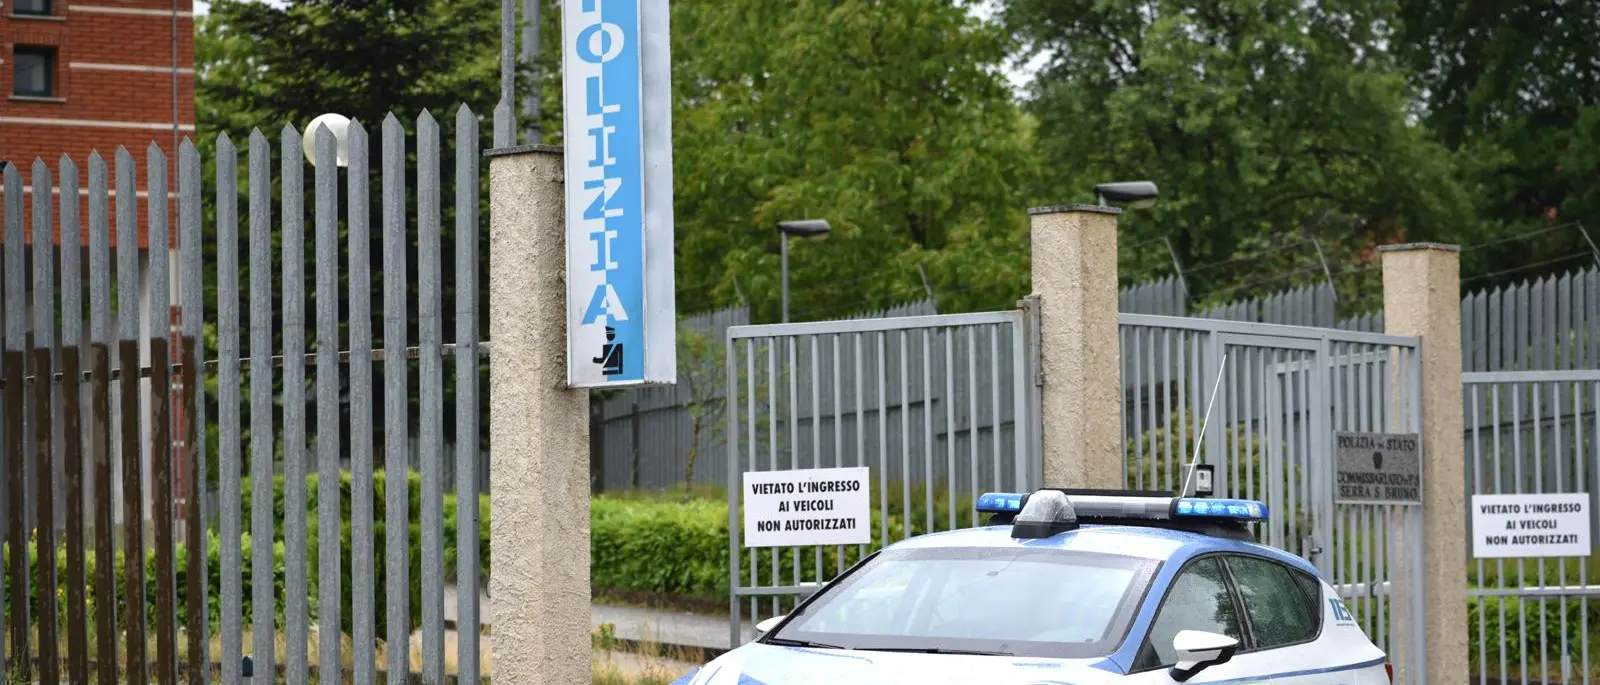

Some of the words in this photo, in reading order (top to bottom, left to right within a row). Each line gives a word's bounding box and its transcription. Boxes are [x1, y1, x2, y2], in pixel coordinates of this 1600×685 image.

[575, 0, 629, 324] OLIZIA
[1386, 439, 1416, 451] STATO
[752, 483, 794, 495] VIETATO
[798, 480, 860, 493] L'INGRESSO
[1340, 485, 1371, 497] SERRA
[779, 501, 790, 512] AI
[794, 500, 833, 512] VEICOLI
[1481, 504, 1521, 514] VIETATO
[1524, 503, 1582, 513] L'INGRESSO
[757, 521, 780, 532] NON
[785, 518, 856, 531] AUTORIZZATI
[1506, 520, 1516, 530] AI
[1520, 519, 1557, 529] VEICOLI
[1486, 536, 1508, 545] NON
[1511, 534, 1578, 545] AUTORIZZATI
